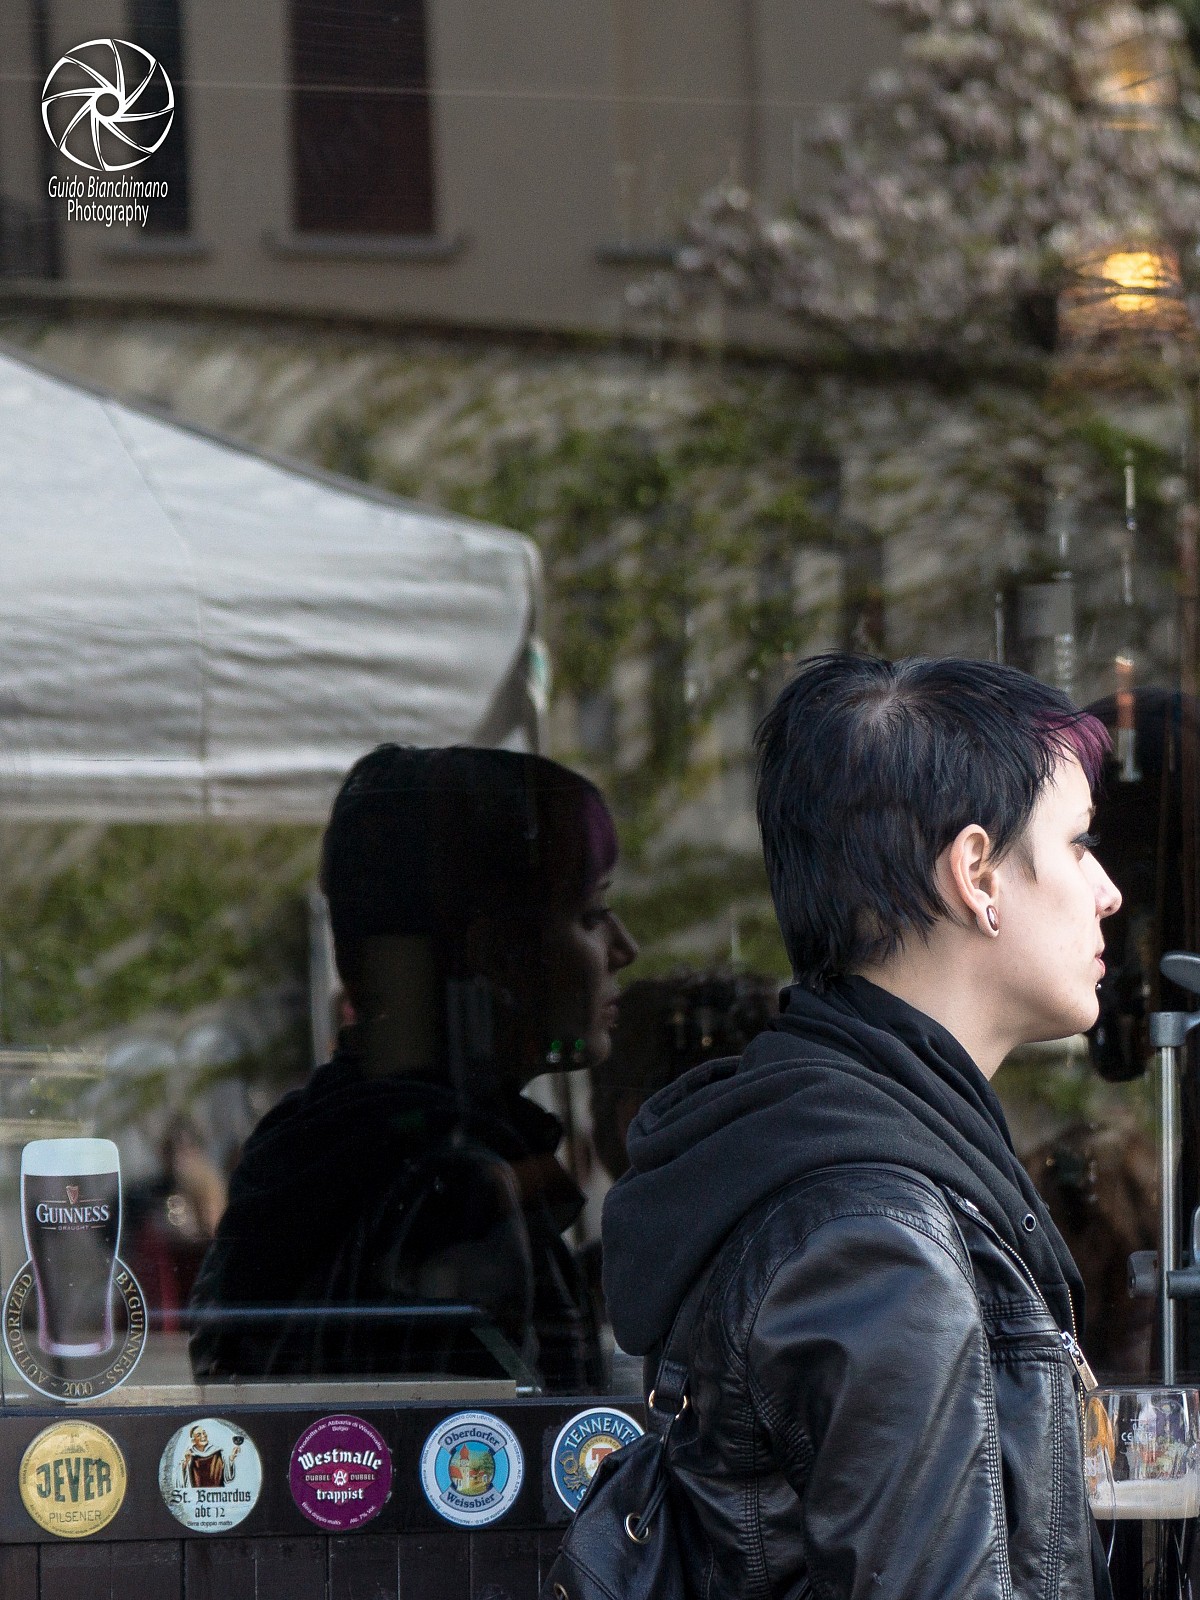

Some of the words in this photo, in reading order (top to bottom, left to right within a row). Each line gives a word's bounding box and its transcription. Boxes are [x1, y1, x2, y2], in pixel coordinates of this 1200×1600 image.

[35, 1203, 110, 1224] GUINNESS
[7, 1273, 48, 1384] AUTHORIZED
[62, 1381, 93, 1396] 2000
[298, 1428, 318, 1453] Prodotta
[444, 1428, 500, 1447] Oberdorfer
[298, 1449, 382, 1470] Westmalle
[36, 1457, 112, 1503] JEVER
[171, 1489, 191, 1504] St.
[195, 1488, 252, 1504] Bernardus
[316, 1488, 364, 1504] trappist
[446, 1492, 496, 1509] Weissbier
[49, 1510, 102, 1523] PILSENER
